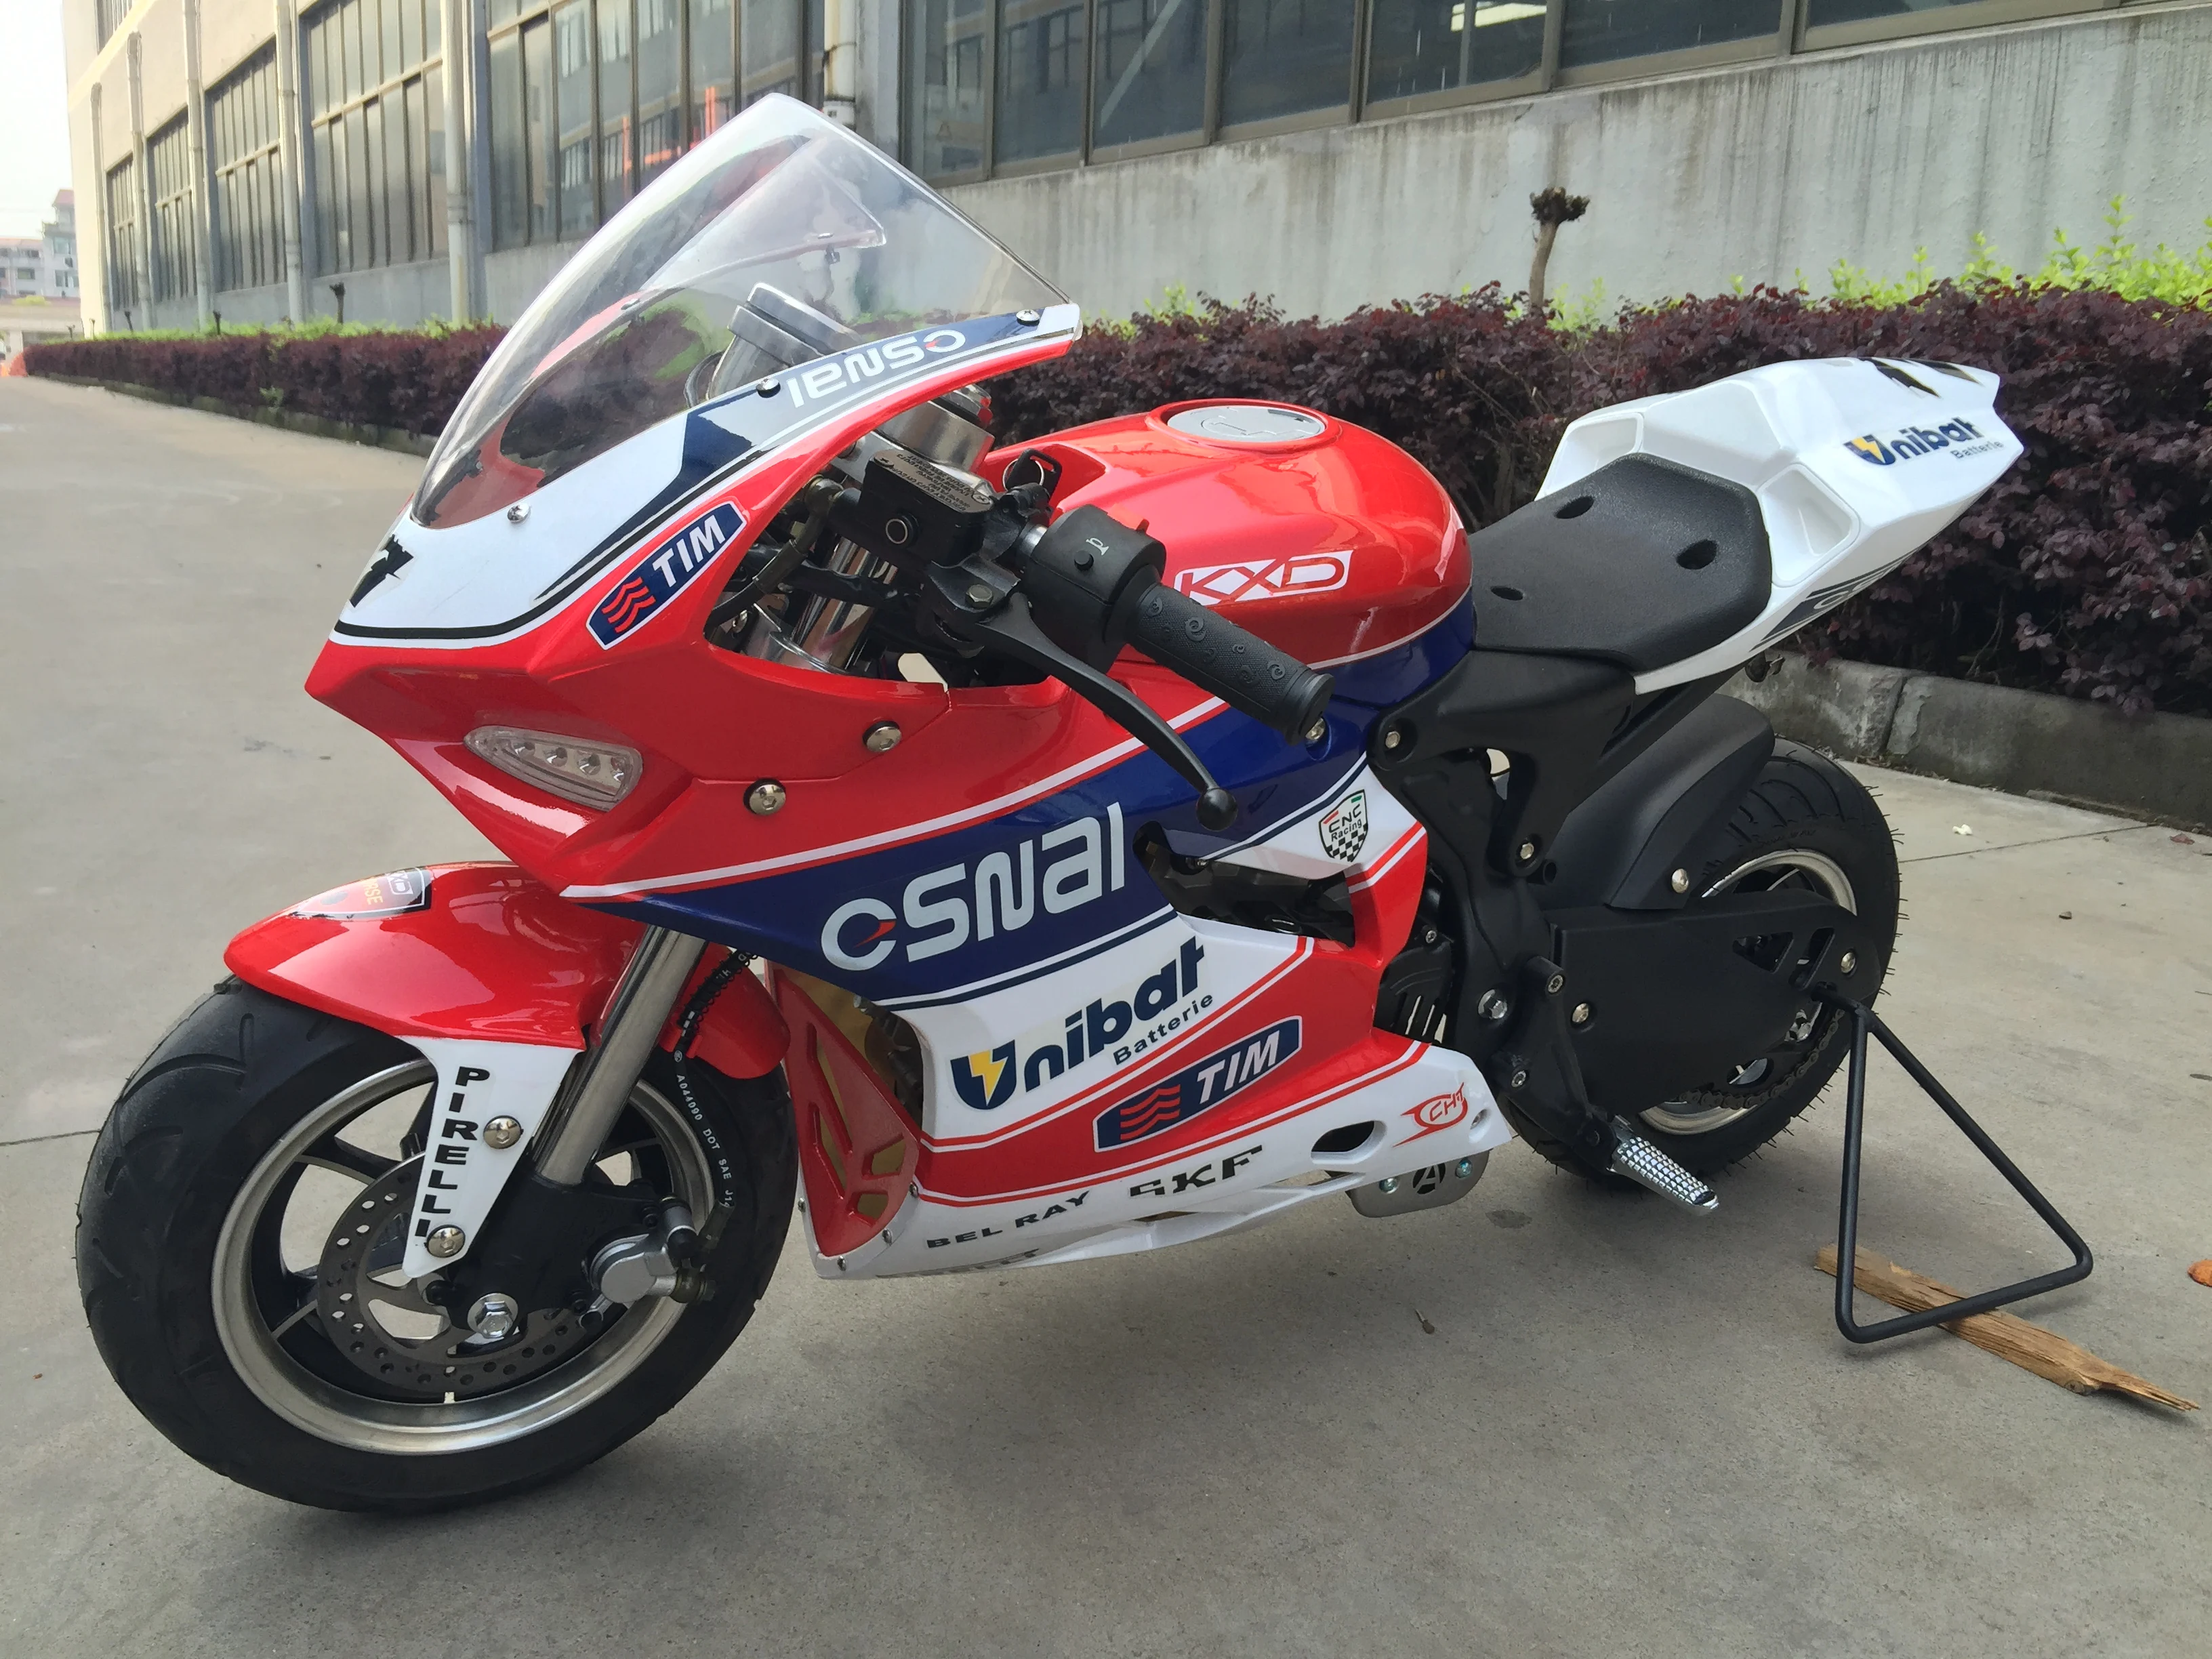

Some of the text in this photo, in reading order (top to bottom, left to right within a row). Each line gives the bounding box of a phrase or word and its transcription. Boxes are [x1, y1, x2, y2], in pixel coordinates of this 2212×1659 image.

[1843, 416, 1985, 466] Unibat
[1950, 440, 2005, 459] Batterie
[652, 514, 725, 588] TIM
[1179, 552, 1347, 603] KXD
[1328, 804, 1361, 833] CNC
[1331, 819, 1362, 842] Racing
[950, 936, 1204, 1109] Unibat
[1113, 992, 1214, 1065] Batterie
[1197, 1029, 1280, 1105] TIM
[414, 1066, 490, 1237] PIRELLI
[676, 1074, 703, 1121] A044090
[702, 1128, 720, 1150] DOT
[718, 1159, 732, 1180] SAE
[926, 1191, 1089, 1248] BEL RAY
